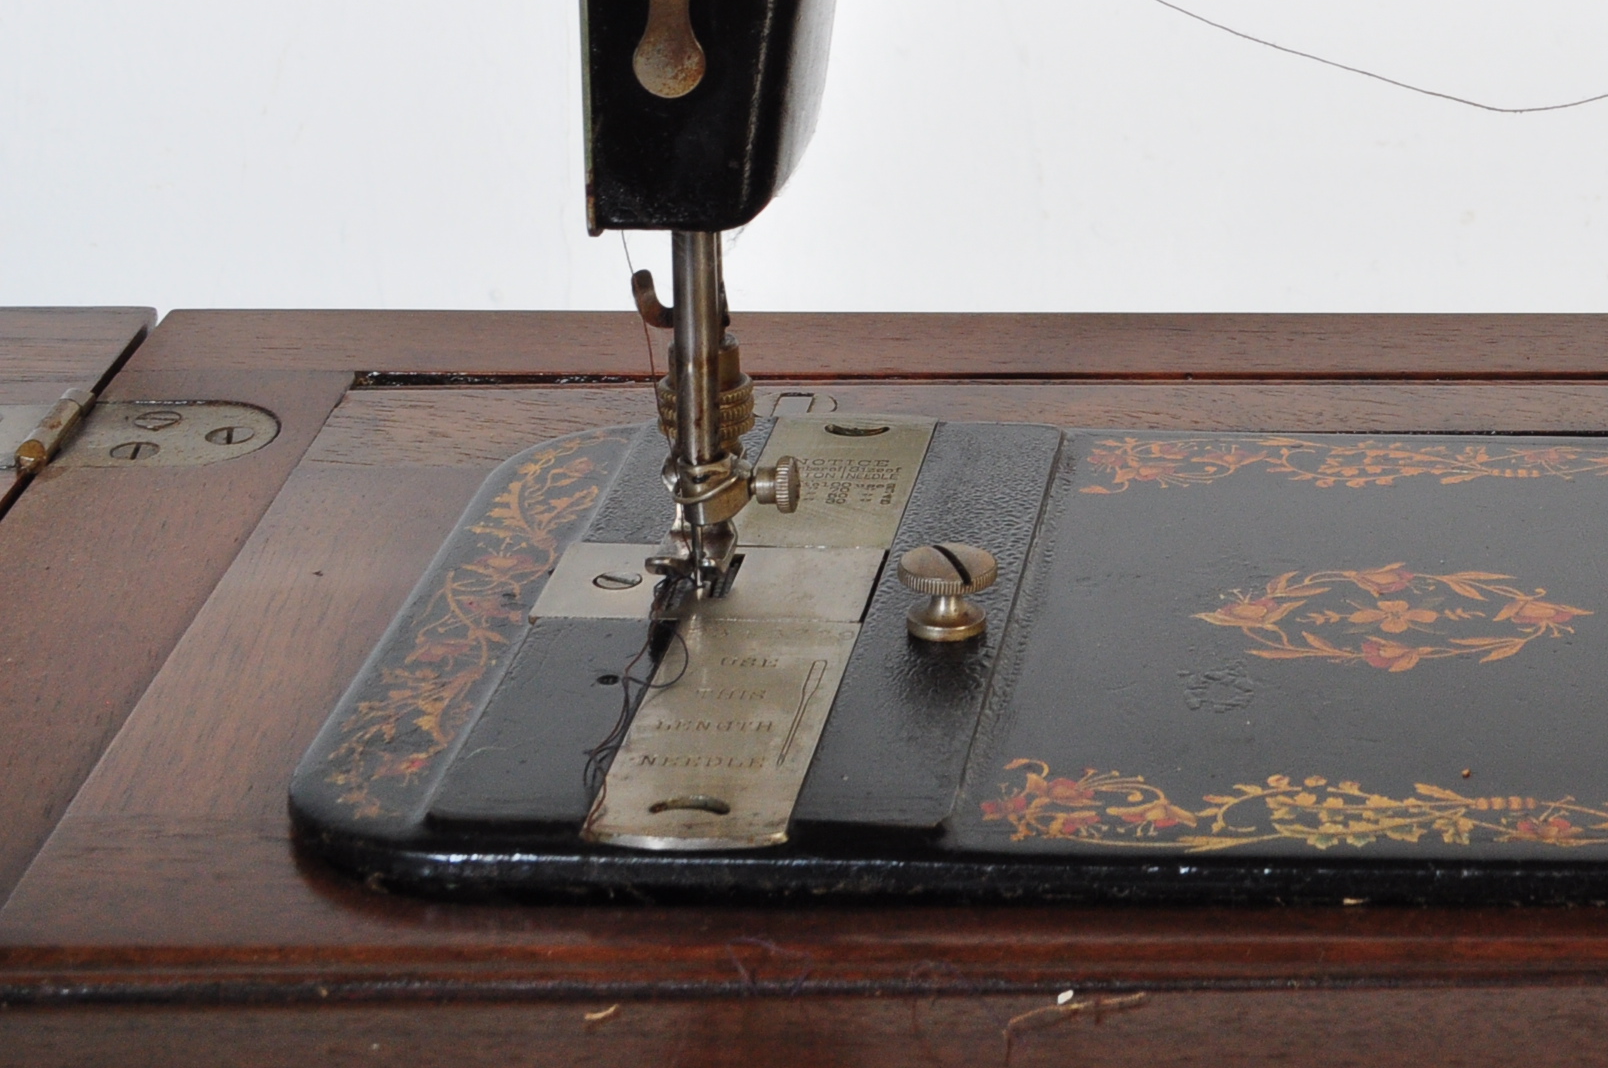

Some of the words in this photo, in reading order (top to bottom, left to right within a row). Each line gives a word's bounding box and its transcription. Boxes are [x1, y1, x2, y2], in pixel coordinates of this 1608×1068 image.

[796, 458, 890, 468] NOTICE
[845, 473, 900, 481] NEEDLE
[721, 656, 779, 668] USE
[697, 688, 767, 700] THIS
[656, 720, 773, 732] LENGTH
[639, 754, 766, 769] NEEDLE
